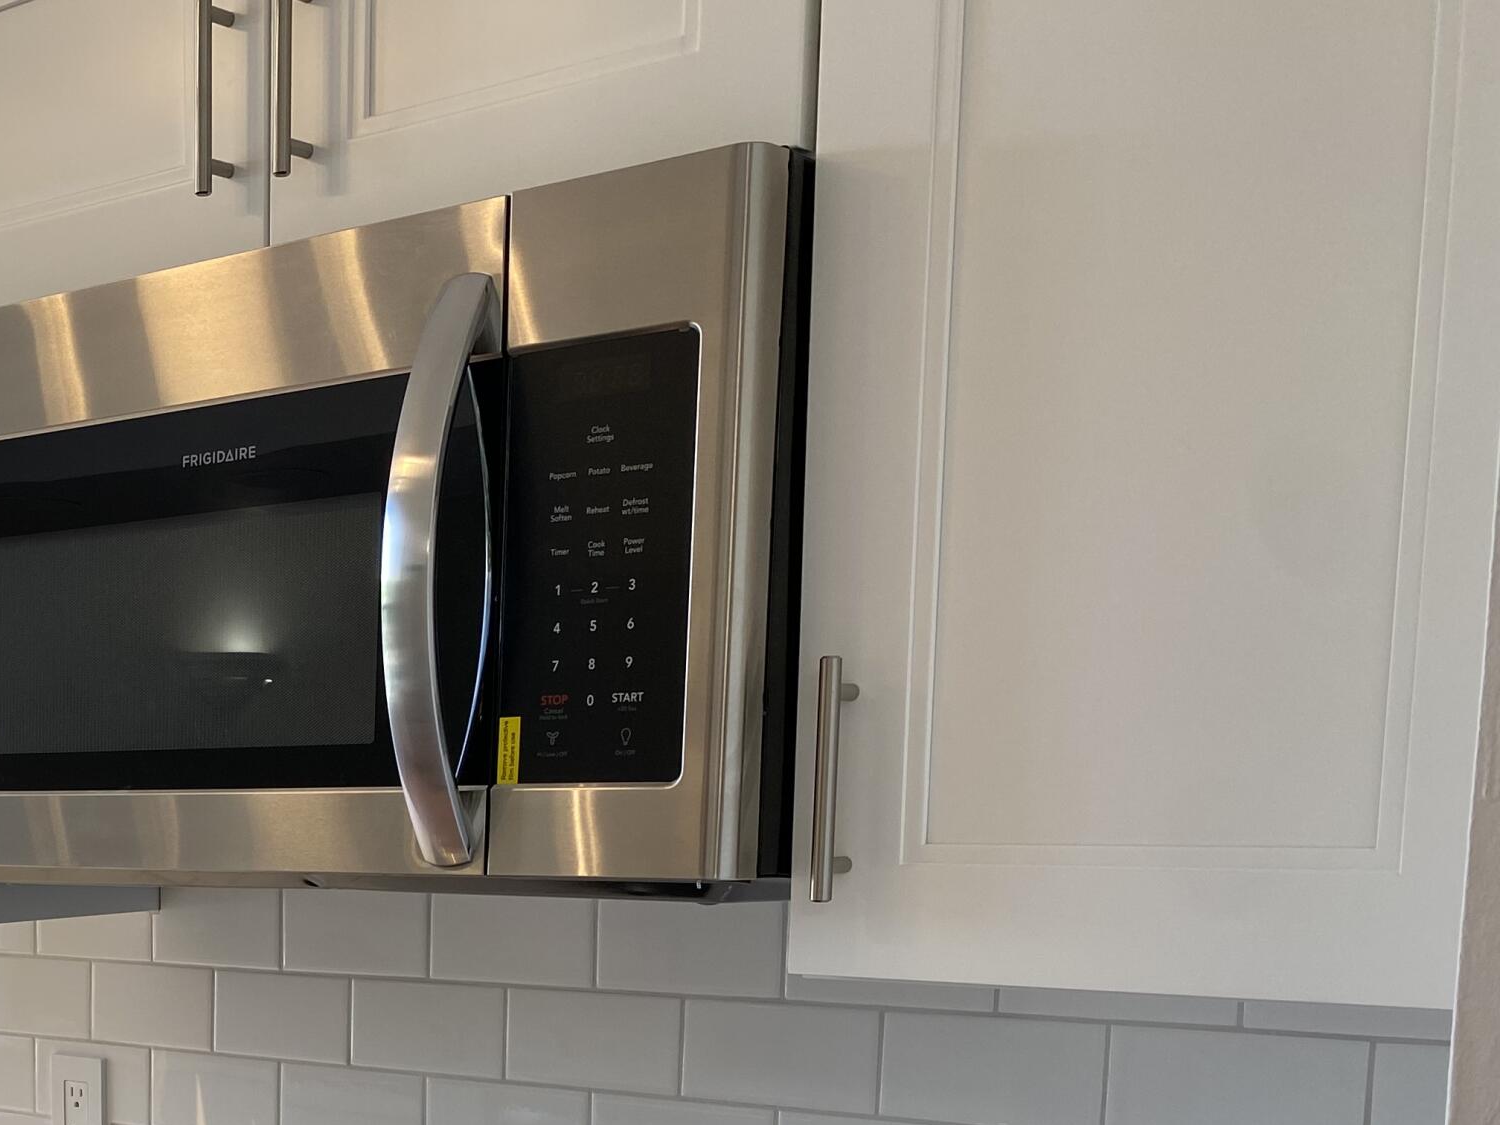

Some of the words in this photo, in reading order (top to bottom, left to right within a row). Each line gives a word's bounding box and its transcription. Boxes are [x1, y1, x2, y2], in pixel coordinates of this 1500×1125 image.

[591, 424, 610, 434] Clock
[586, 433, 615, 444] Settings
[182, 446, 256, 468] FRIGIDAIRE
[588, 467, 611, 476] Potato
[620, 462, 653, 472] Beverage
[549, 471, 577, 481] Popcorn
[622, 497, 649, 507] Defrost
[553, 505, 569, 514] Melt
[586, 506, 610, 515] Reheat
[621, 506, 649, 515] wt/time
[550, 514, 572, 523] Soften
[588, 540, 605, 549] Cook
[623, 537, 645, 545] Power
[550, 548, 570, 556] Timer
[588, 549, 605, 557] Time
[624, 545, 643, 554] Level
[555, 584, 561, 596] 1
[590, 581, 599, 594] 2
[628, 578, 636, 591] 3
[553, 622, 561, 634] 4
[589, 619, 597, 632] 5
[627, 617, 635, 630] 6
[552, 660, 559, 672] 7
[588, 658, 596, 670] 8
[625, 656, 633, 668] 9
[541, 694, 568, 706] STOP
[586, 694, 594, 706] 0
[611, 691, 644, 703] START
[500, 753, 508, 781] Remove
